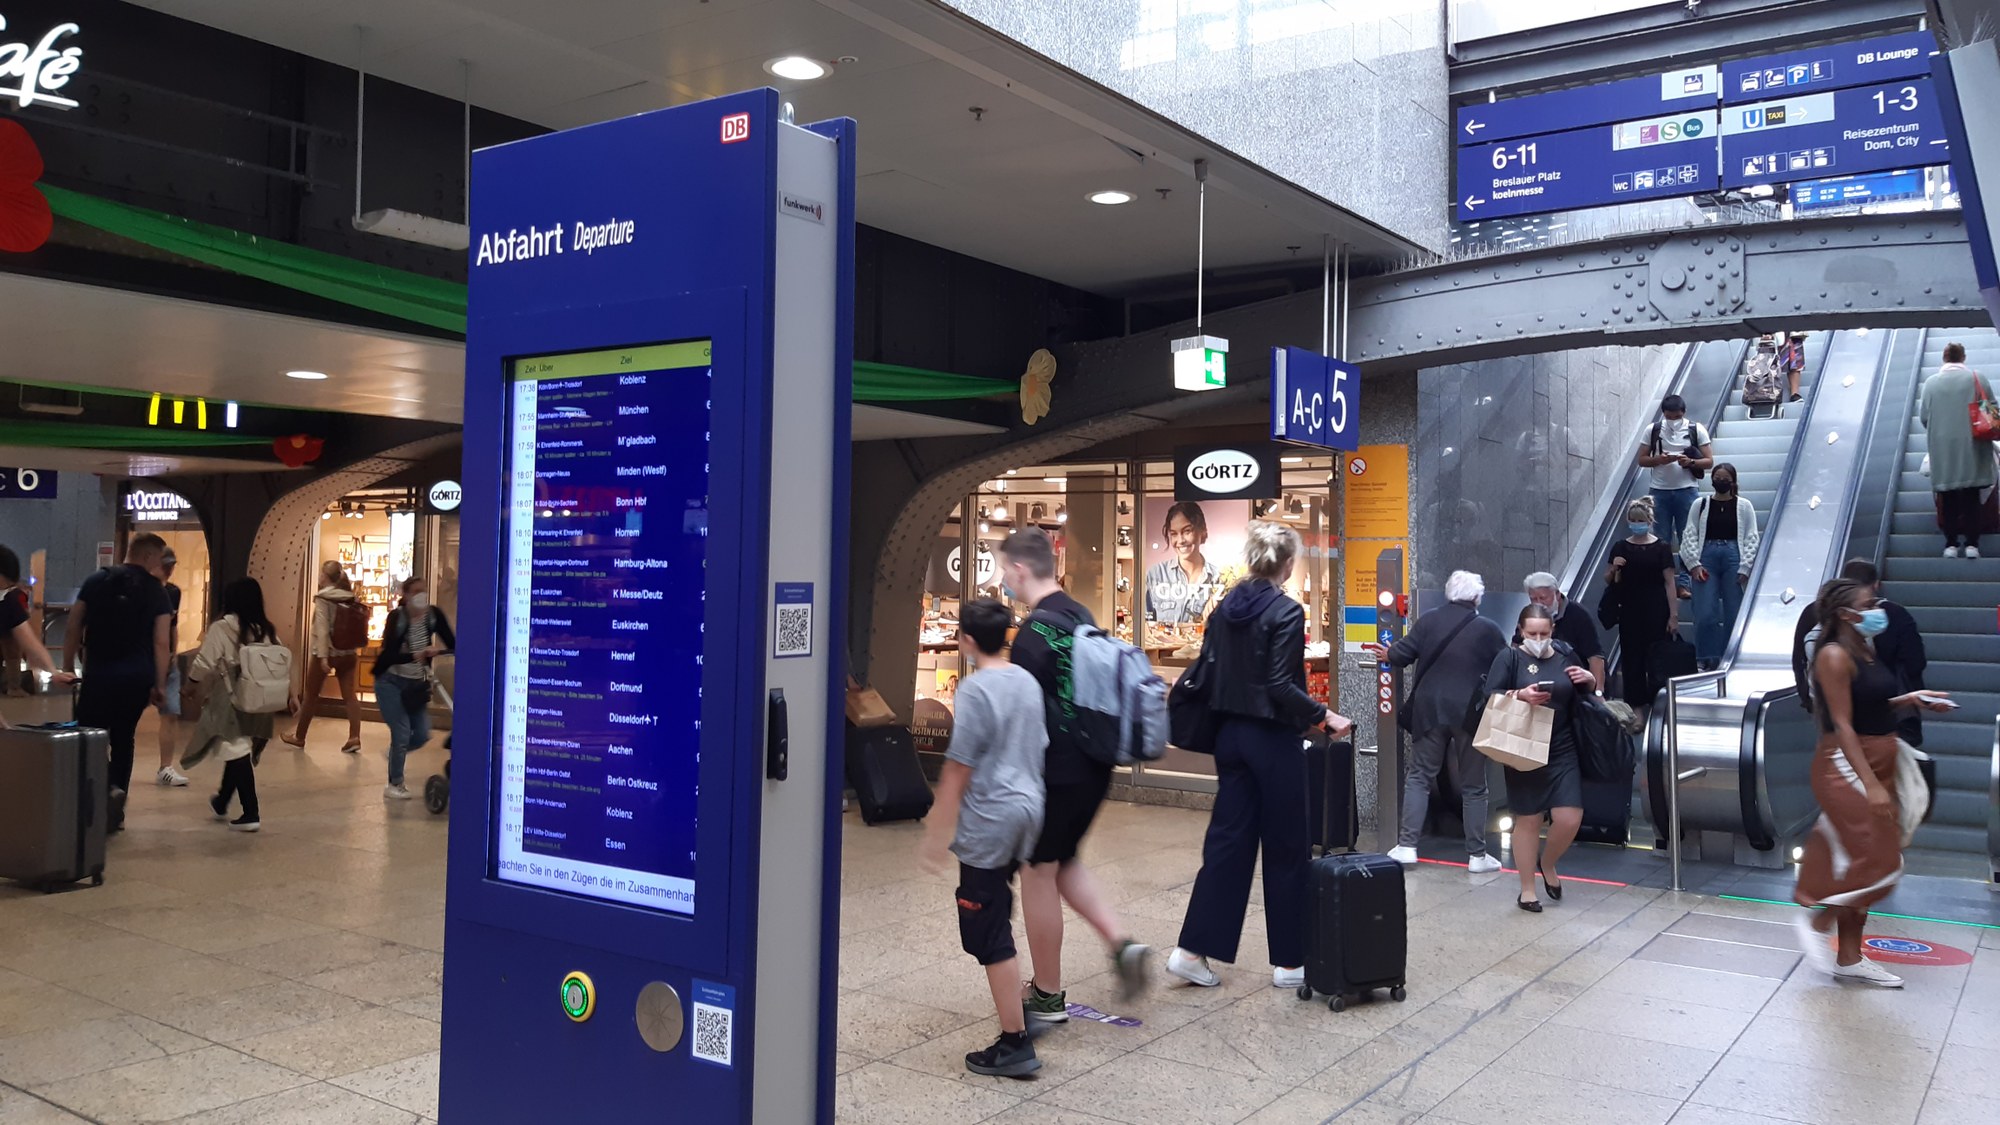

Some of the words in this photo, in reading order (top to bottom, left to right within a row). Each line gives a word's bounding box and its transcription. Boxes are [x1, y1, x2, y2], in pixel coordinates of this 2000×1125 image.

[0, 13, 82, 107] afé
[1858, 53, 1874, 65] DB
[1877, 47, 1918, 62] Lounge
[1873, 86, 1918, 114] 1-3
[1767, 112, 1784, 120] TAXI
[724, 118, 746, 140] DB
[1686, 124, 1700, 132] Bus
[1843, 122, 1919, 140] Reisezentrum
[1864, 138, 1894, 150] Dom,
[1897, 135, 1919, 149] City
[1492, 143, 1537, 169] 6-11
[1492, 175, 1536, 188] Breslauer
[1538, 171, 1561, 184] Platz
[1614, 182, 1628, 191] WC
[1492, 186, 1544, 200] koelnmesse
[784, 197, 815, 214] funkwerk
[476, 222, 563, 266] Abfahrt
[574, 218, 634, 256] Departure
[620, 356, 633, 364] Ziel
[524, 364, 536, 374] Zeit
[620, 375, 646, 385] Koblenz
[520, 384, 536, 393] 17:38
[1292, 388, 1322, 430] A-C
[1330, 370, 1347, 434] 5
[618, 404, 649, 416] München
[518, 442, 534, 450] 17:59
[517, 470, 533, 480] 18:07
[617, 466, 641, 476] Minden
[642, 465, 667, 476] (Westf)
[18, 468, 39, 491] 6
[516, 500, 532, 508] 18:07
[616, 498, 633, 507] Bonn
[634, 496, 647, 506] Hbf
[515, 529, 532, 538] 18:10
[615, 528, 640, 537] Horrem
[515, 558, 530, 567] 18:11
[614, 558, 668, 570] Hamburg-Altona
[951, 558, 990, 572] GTZ
[514, 588, 529, 596] 18:11
[613, 590, 618, 598] K
[620, 590, 663, 600] Messe/Deutz
[513, 617, 528, 626] 18:11
[612, 620, 648, 630] Euskirchen
[512, 646, 527, 655] 18:11
[611, 651, 635, 661] Hennef
[511, 676, 526, 684] 18:11
[610, 682, 642, 693] Dortmund
[653, 716, 658, 726] T
[608, 744, 633, 756] Aachen
[508, 764, 523, 773] 18:17
[608, 776, 626, 786] Berlin
[628, 778, 658, 790] Ostkreuz
[506, 794, 522, 803] 18:17
[606, 807, 633, 820] Koblenz
[506, 824, 521, 833] 18:17
[606, 838, 626, 850] Essen
[530, 862, 542, 876] Sie
[544, 866, 552, 878] in
[554, 868, 570, 881] den
[572, 870, 598, 886] Zügen
[600, 876, 613, 888] die
[616, 878, 626, 892] im
